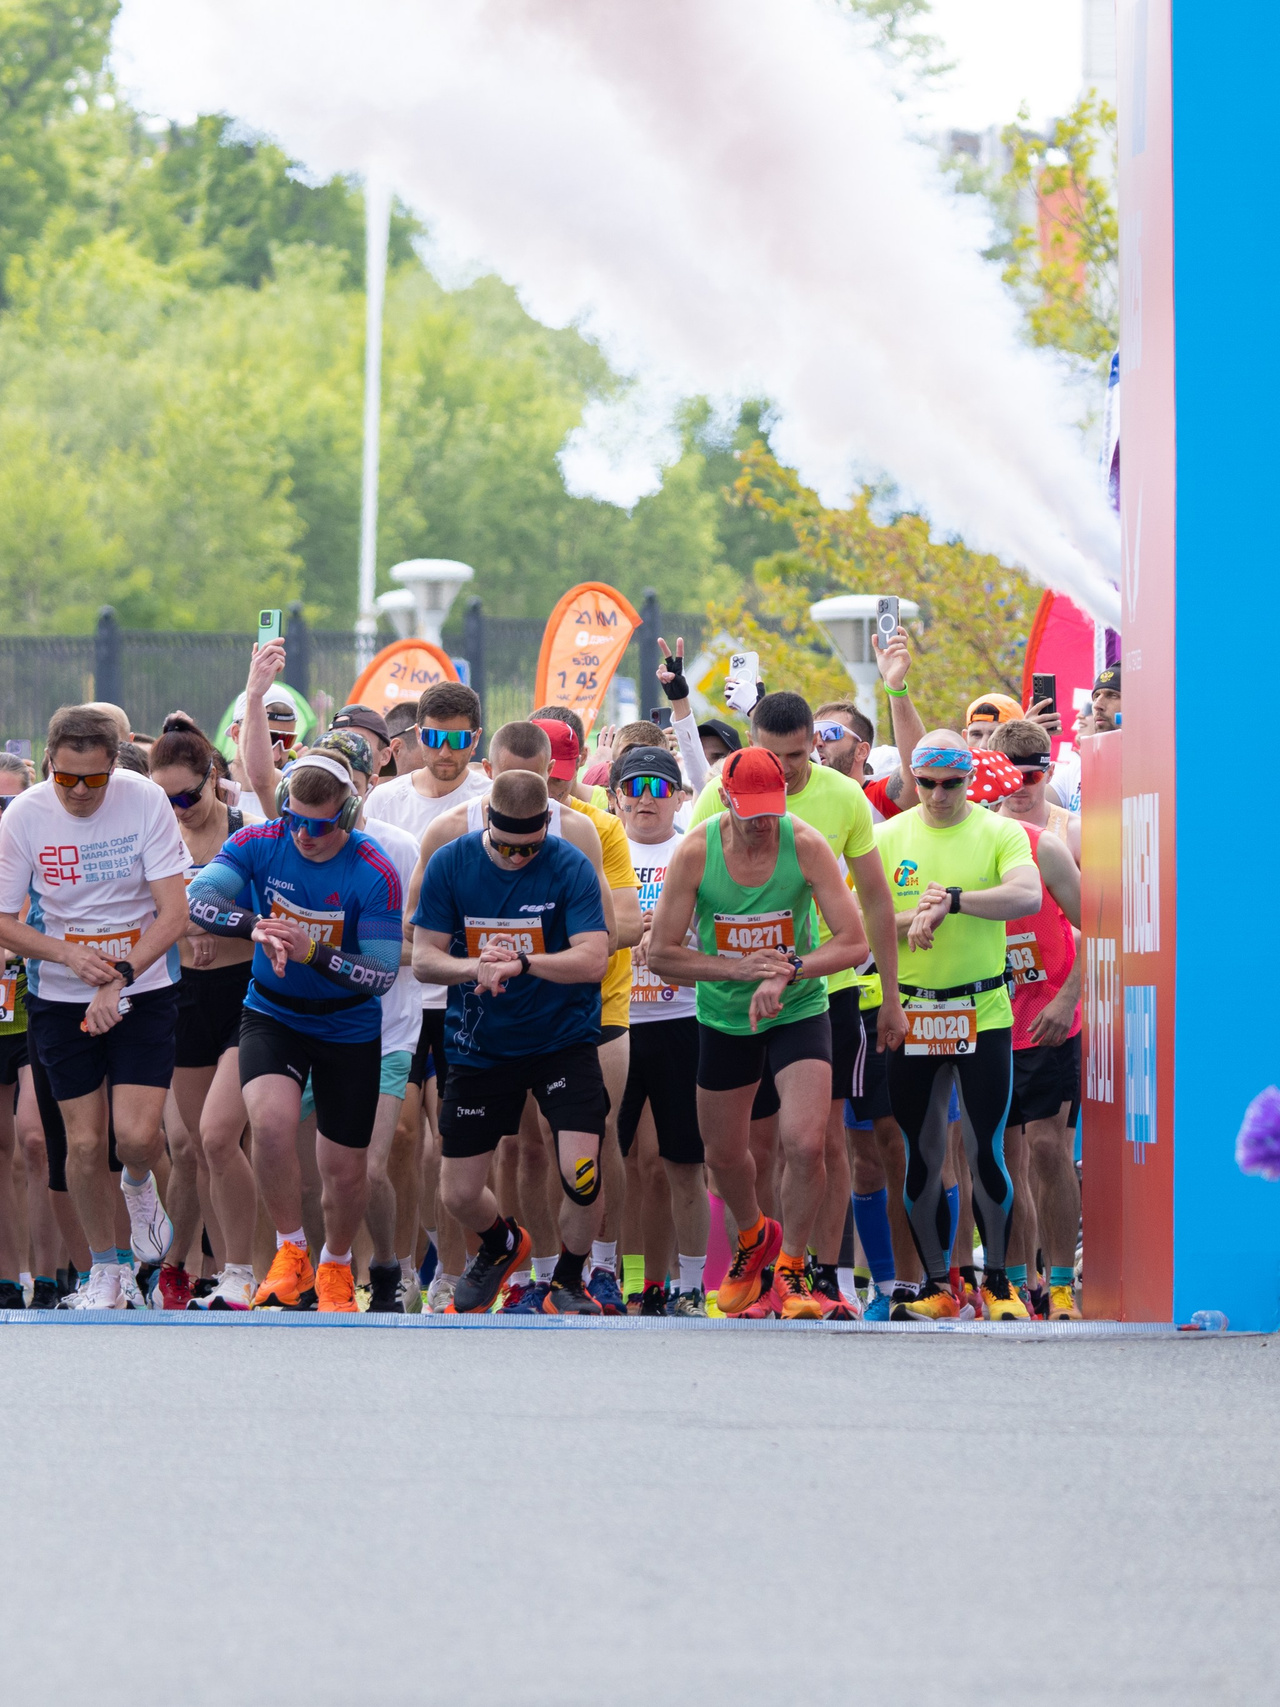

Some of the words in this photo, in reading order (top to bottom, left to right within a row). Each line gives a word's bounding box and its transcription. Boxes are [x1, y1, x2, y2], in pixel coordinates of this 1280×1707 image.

[575, 609, 591, 625] 21
[572, 655, 599, 666] 5:00
[389, 662, 407, 680] 21
[557, 671, 566, 688] 1
[576, 672, 598, 689] 45
[39, 845, 80, 866] 20
[80, 841, 108, 853] CHINA
[110, 833, 139, 847] COAST
[81, 845, 134, 861] MARATHON
[44, 867, 82, 886] 24
[267, 876, 296, 891] LUKOIL
[279, 913, 334, 942] 387
[727, 924, 783, 948] 40271
[78, 936, 132, 959] 105
[328, 955, 395, 989] SPORTS
[912, 1015, 970, 1040] 40020
